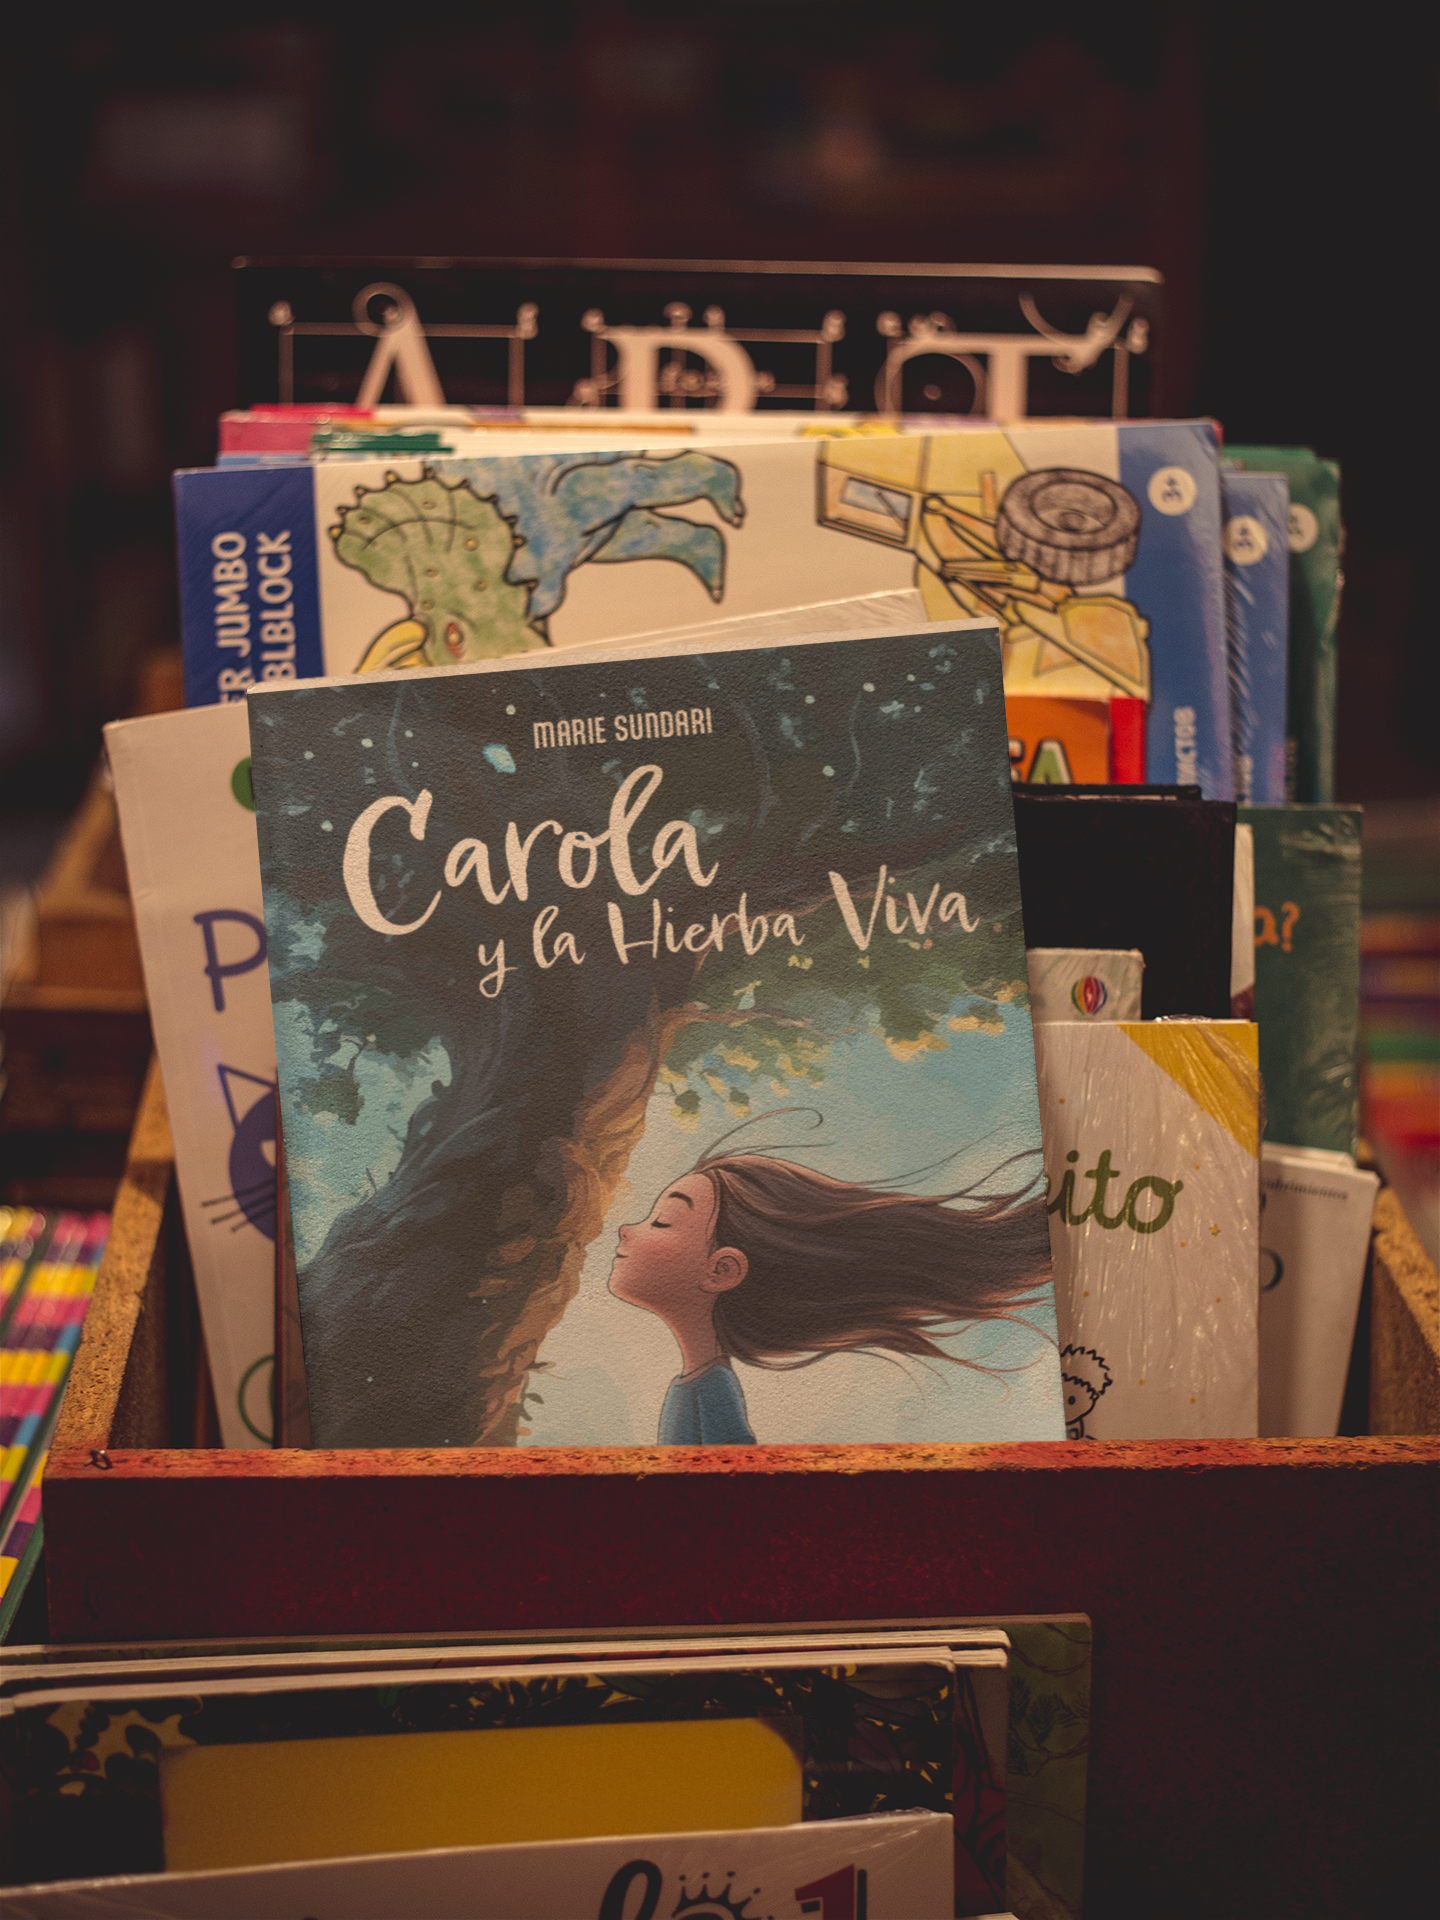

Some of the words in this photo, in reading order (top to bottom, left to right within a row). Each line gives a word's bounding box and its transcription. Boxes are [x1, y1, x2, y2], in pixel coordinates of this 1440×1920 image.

[211, 531, 252, 658] JUMBO
[256, 530, 298, 682] BLBLOCK
[533, 716, 607, 749] MARIE
[614, 707, 713, 742] SUNDARI
[342, 764, 719, 935] Carola
[193, 908, 267, 1013] P
[478, 938, 518, 998] y
[532, 905, 586, 969] la
[607, 892, 785, 965] Hierba
[828, 864, 981, 951] Viva
[1047, 1149, 1184, 1234] ito
